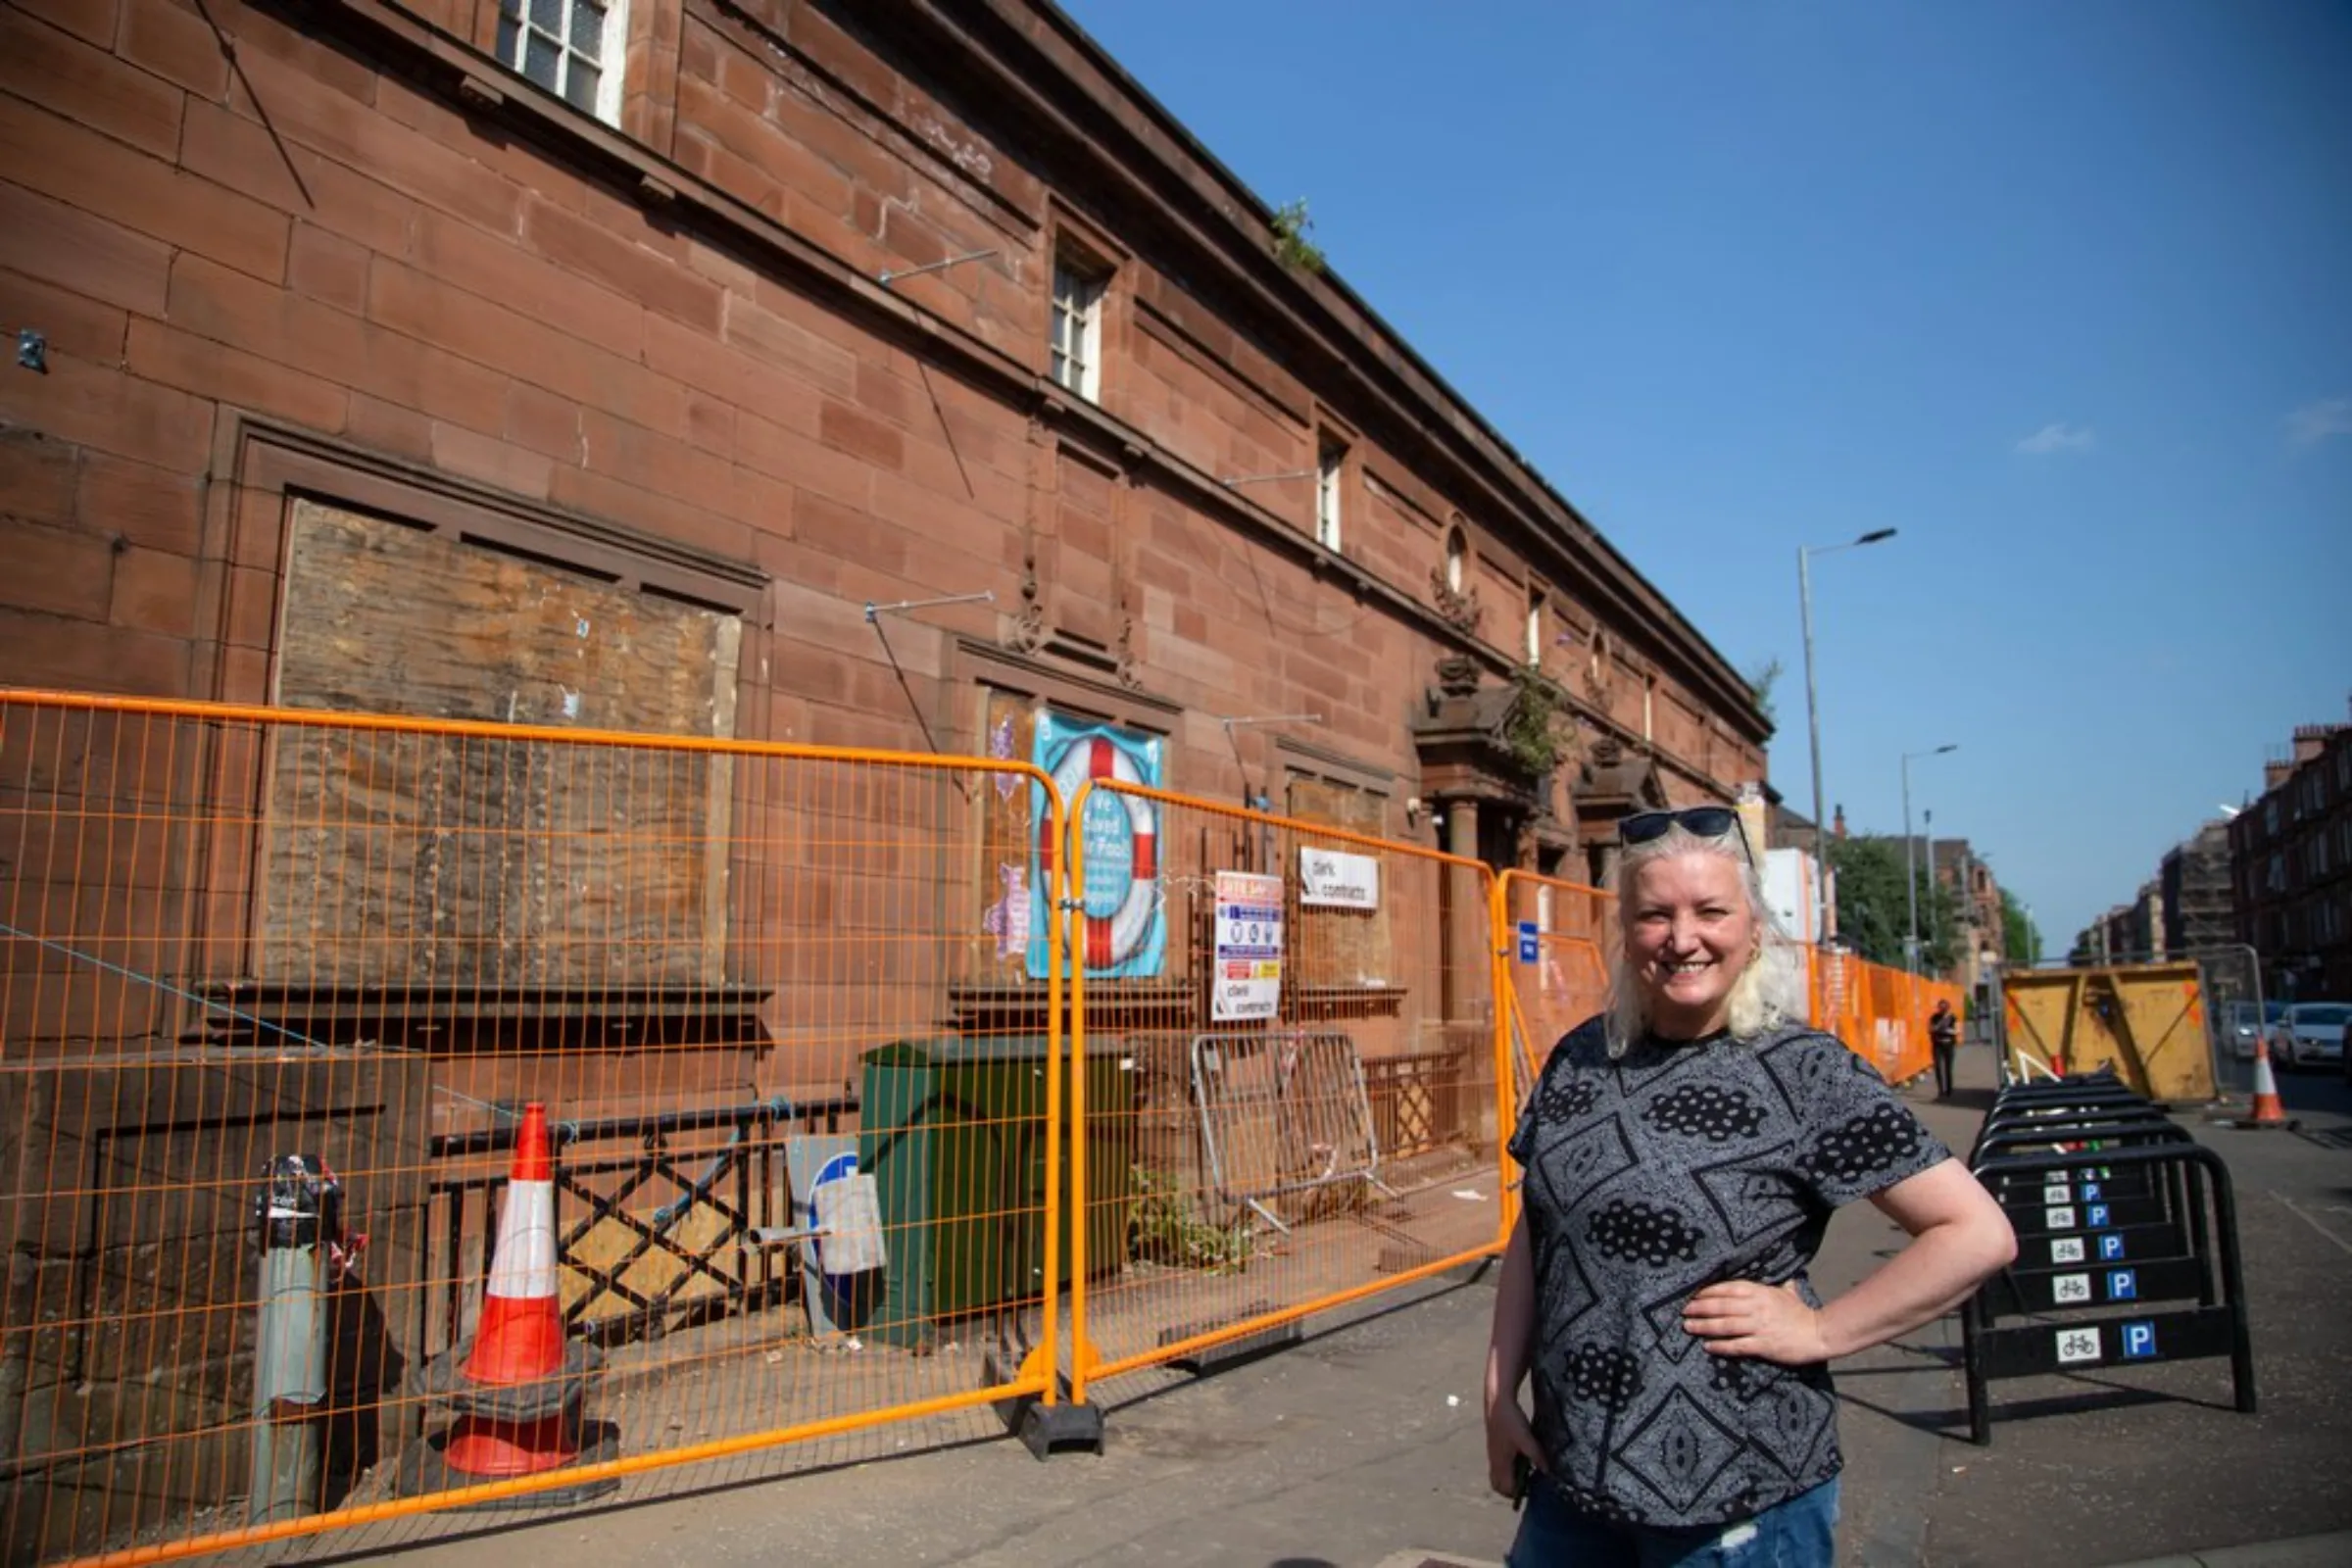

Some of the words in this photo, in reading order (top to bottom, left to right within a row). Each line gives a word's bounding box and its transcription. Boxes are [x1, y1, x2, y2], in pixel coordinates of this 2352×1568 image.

[2085, 1184, 2097, 1200] P
[2092, 1206, 2106, 1224] P
[2104, 1235, 2120, 1258] P
[2113, 1273, 2130, 1297] P
[2130, 1326, 2149, 1354] P
